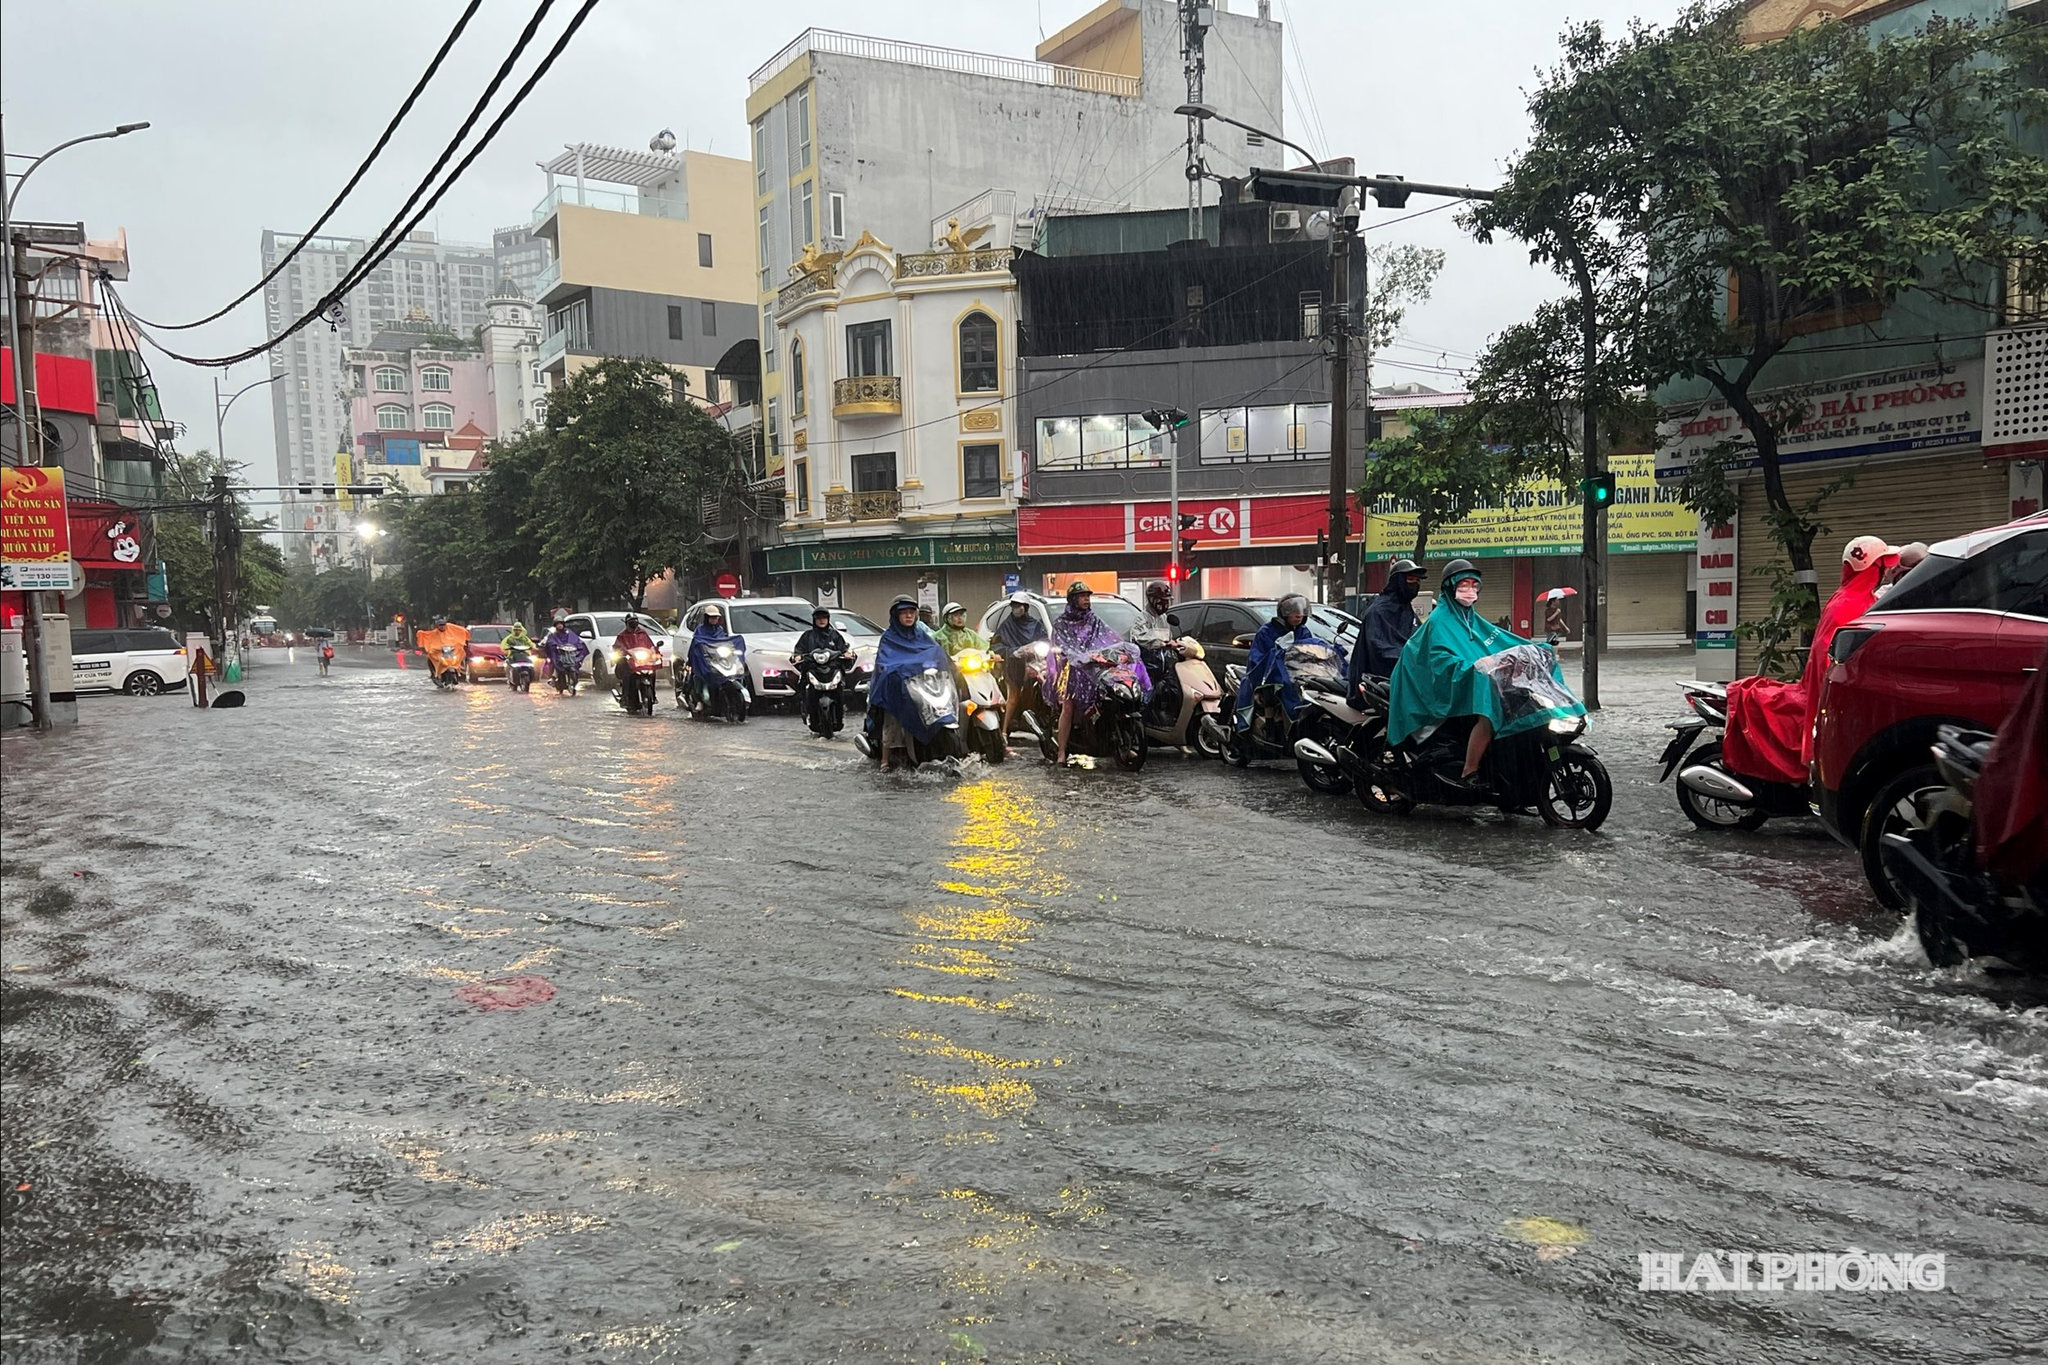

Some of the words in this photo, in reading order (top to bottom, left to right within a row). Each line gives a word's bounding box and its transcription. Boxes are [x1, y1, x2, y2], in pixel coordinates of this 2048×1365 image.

[265, 251, 279, 290] HTEL
[1821, 391, 1868, 418] HẢI
[1872, 381, 1968, 410] PHÒNG
[1946, 415, 1953, 424] Y
[1627, 468, 1650, 477] NHÀ
[1615, 485, 1650, 504] GÀNH
[1, 499, 14, 508] NG
[4, 513, 24, 526] VIỆT
[28, 515, 47, 524] NAM
[1139, 514, 1204, 532] CIRE
[33, 528, 54, 538] VINH
[1498, 525, 1511, 533] LAN
[1528, 524, 1539, 532] TAY
[3, 541, 27, 552] MUÔN
[31, 541, 49, 552] NĂM
[811, 548, 846, 561] VÀNG
[896, 546, 921, 558] GIA
[1461, 550, 1479, 558] Phòng
[1705, 610, 1728, 624] CHI
